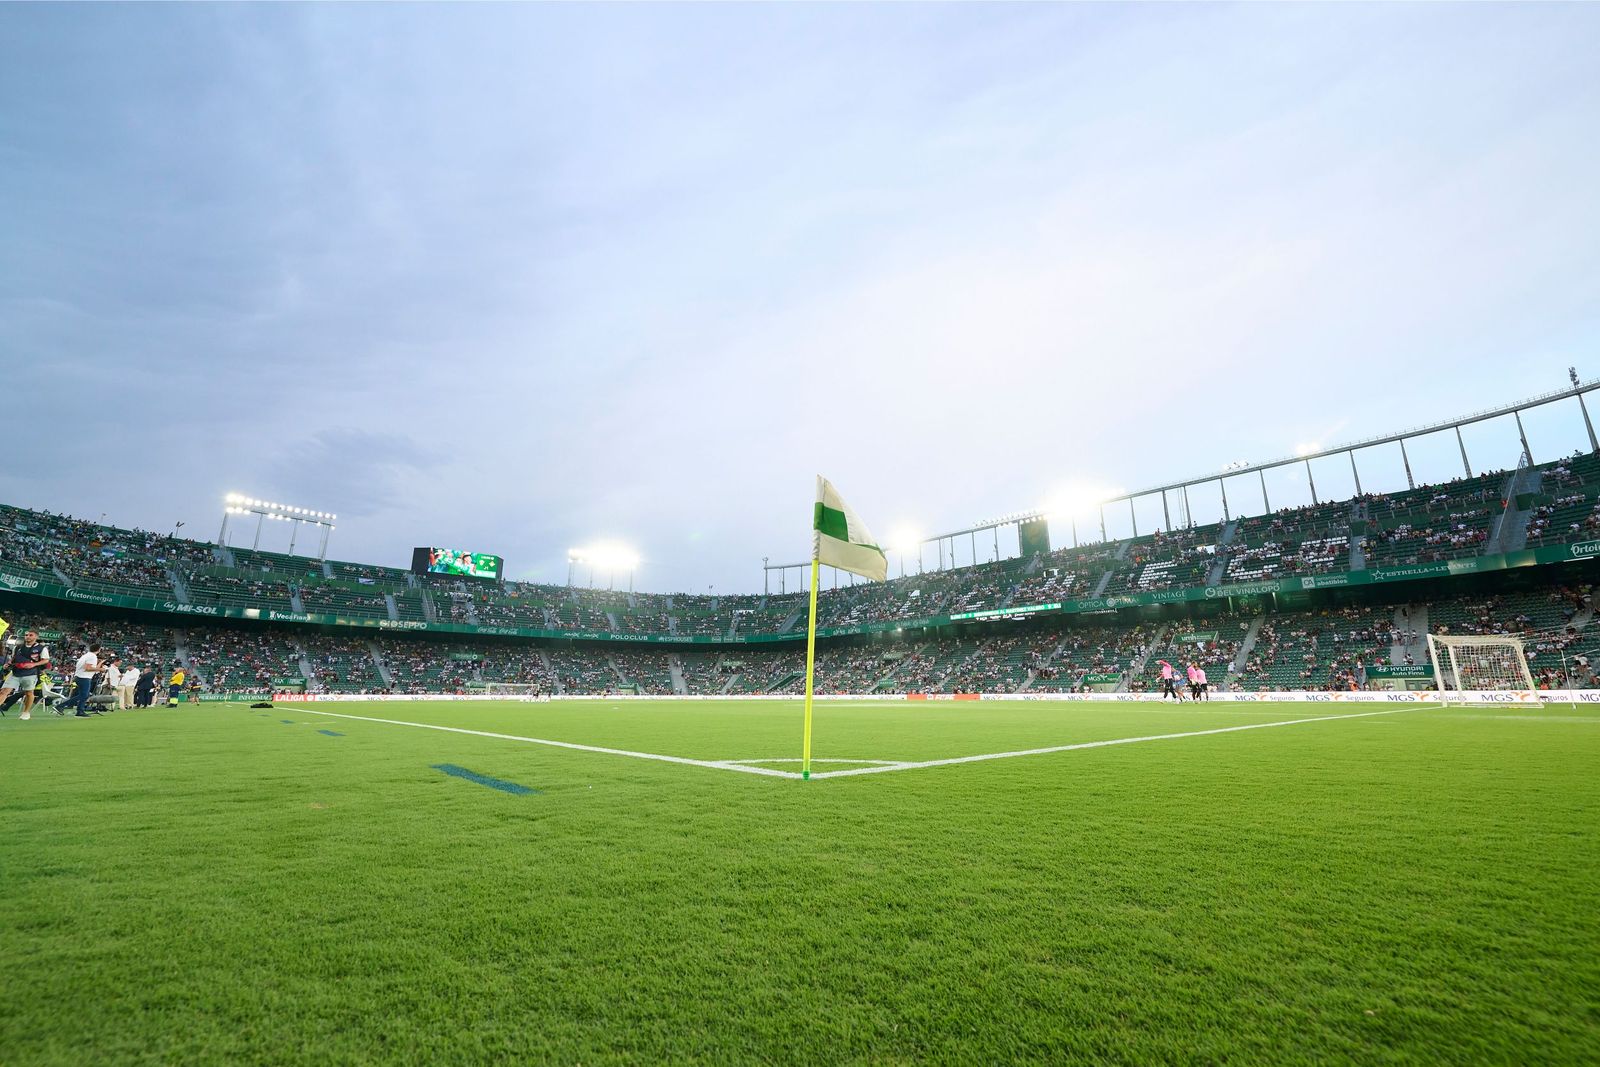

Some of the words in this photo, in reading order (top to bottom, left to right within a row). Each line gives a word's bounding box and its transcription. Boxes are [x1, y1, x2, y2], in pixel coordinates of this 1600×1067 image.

[1387, 567, 1429, 577] ESTRELLA
[1152, 591, 1186, 599] VINTAGE
[1217, 589, 1234, 597] DEL
[177, 604, 217, 614] MI-SOL
